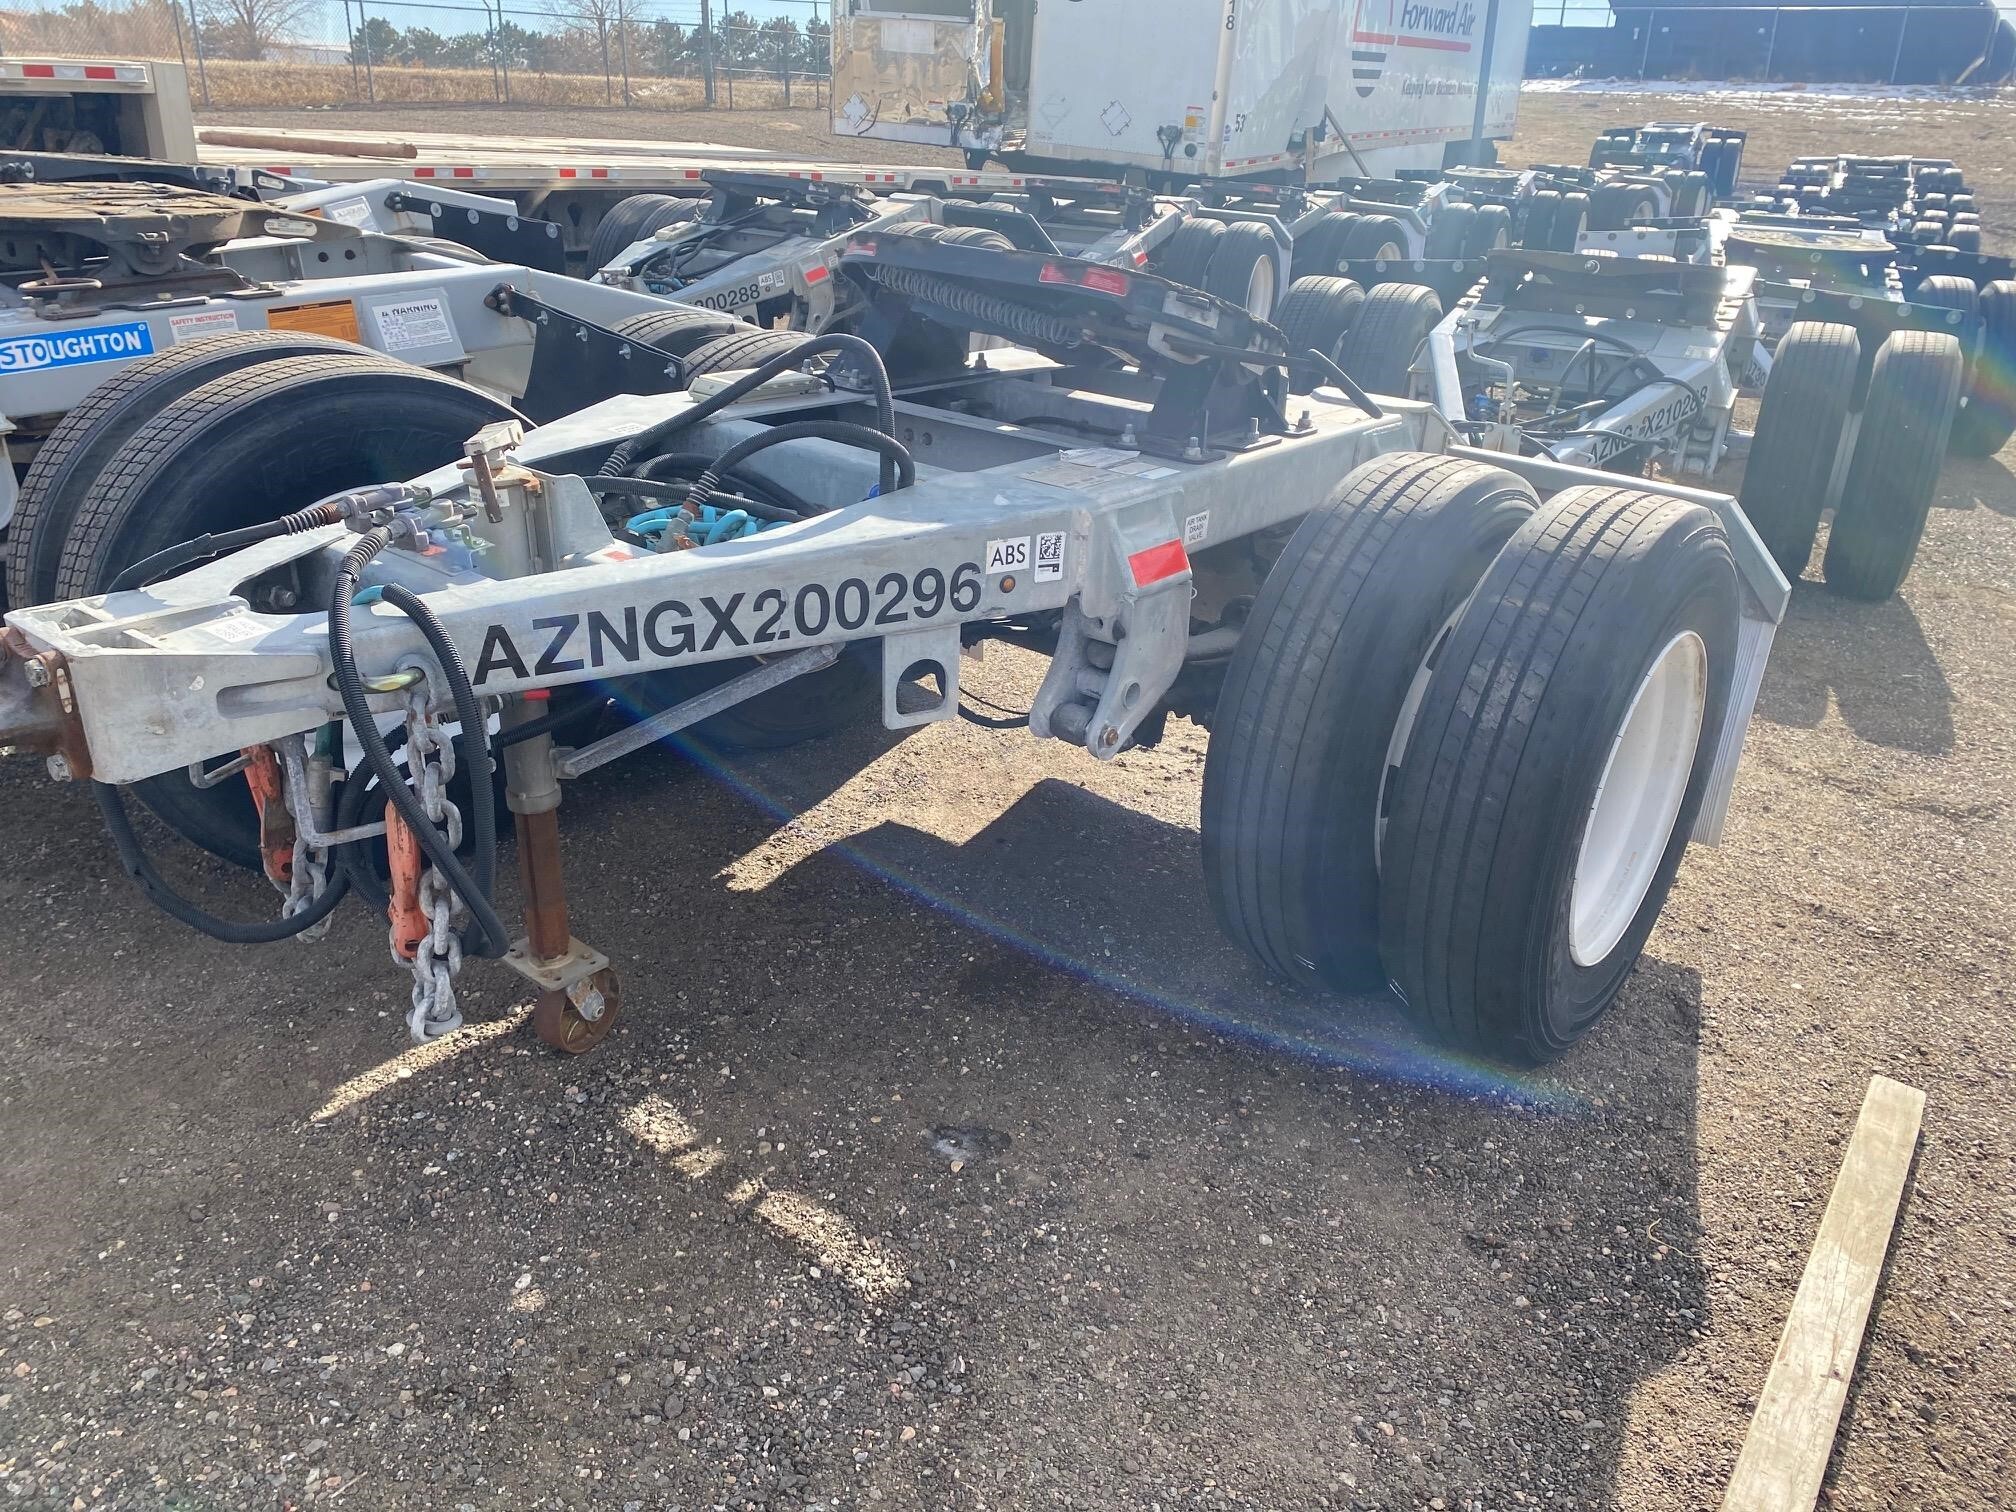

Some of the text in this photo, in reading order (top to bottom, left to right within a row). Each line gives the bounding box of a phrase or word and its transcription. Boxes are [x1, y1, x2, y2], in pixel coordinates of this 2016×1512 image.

[1400, 0, 1459, 34] Forward
[760, 274, 773, 283] ABS
[171, 317, 194, 326] SAFETY
[0, 330, 142, 367] STOUGHTON
[990, 542, 1026, 568] ABS
[473, 562, 982, 686] AZNGX200296
